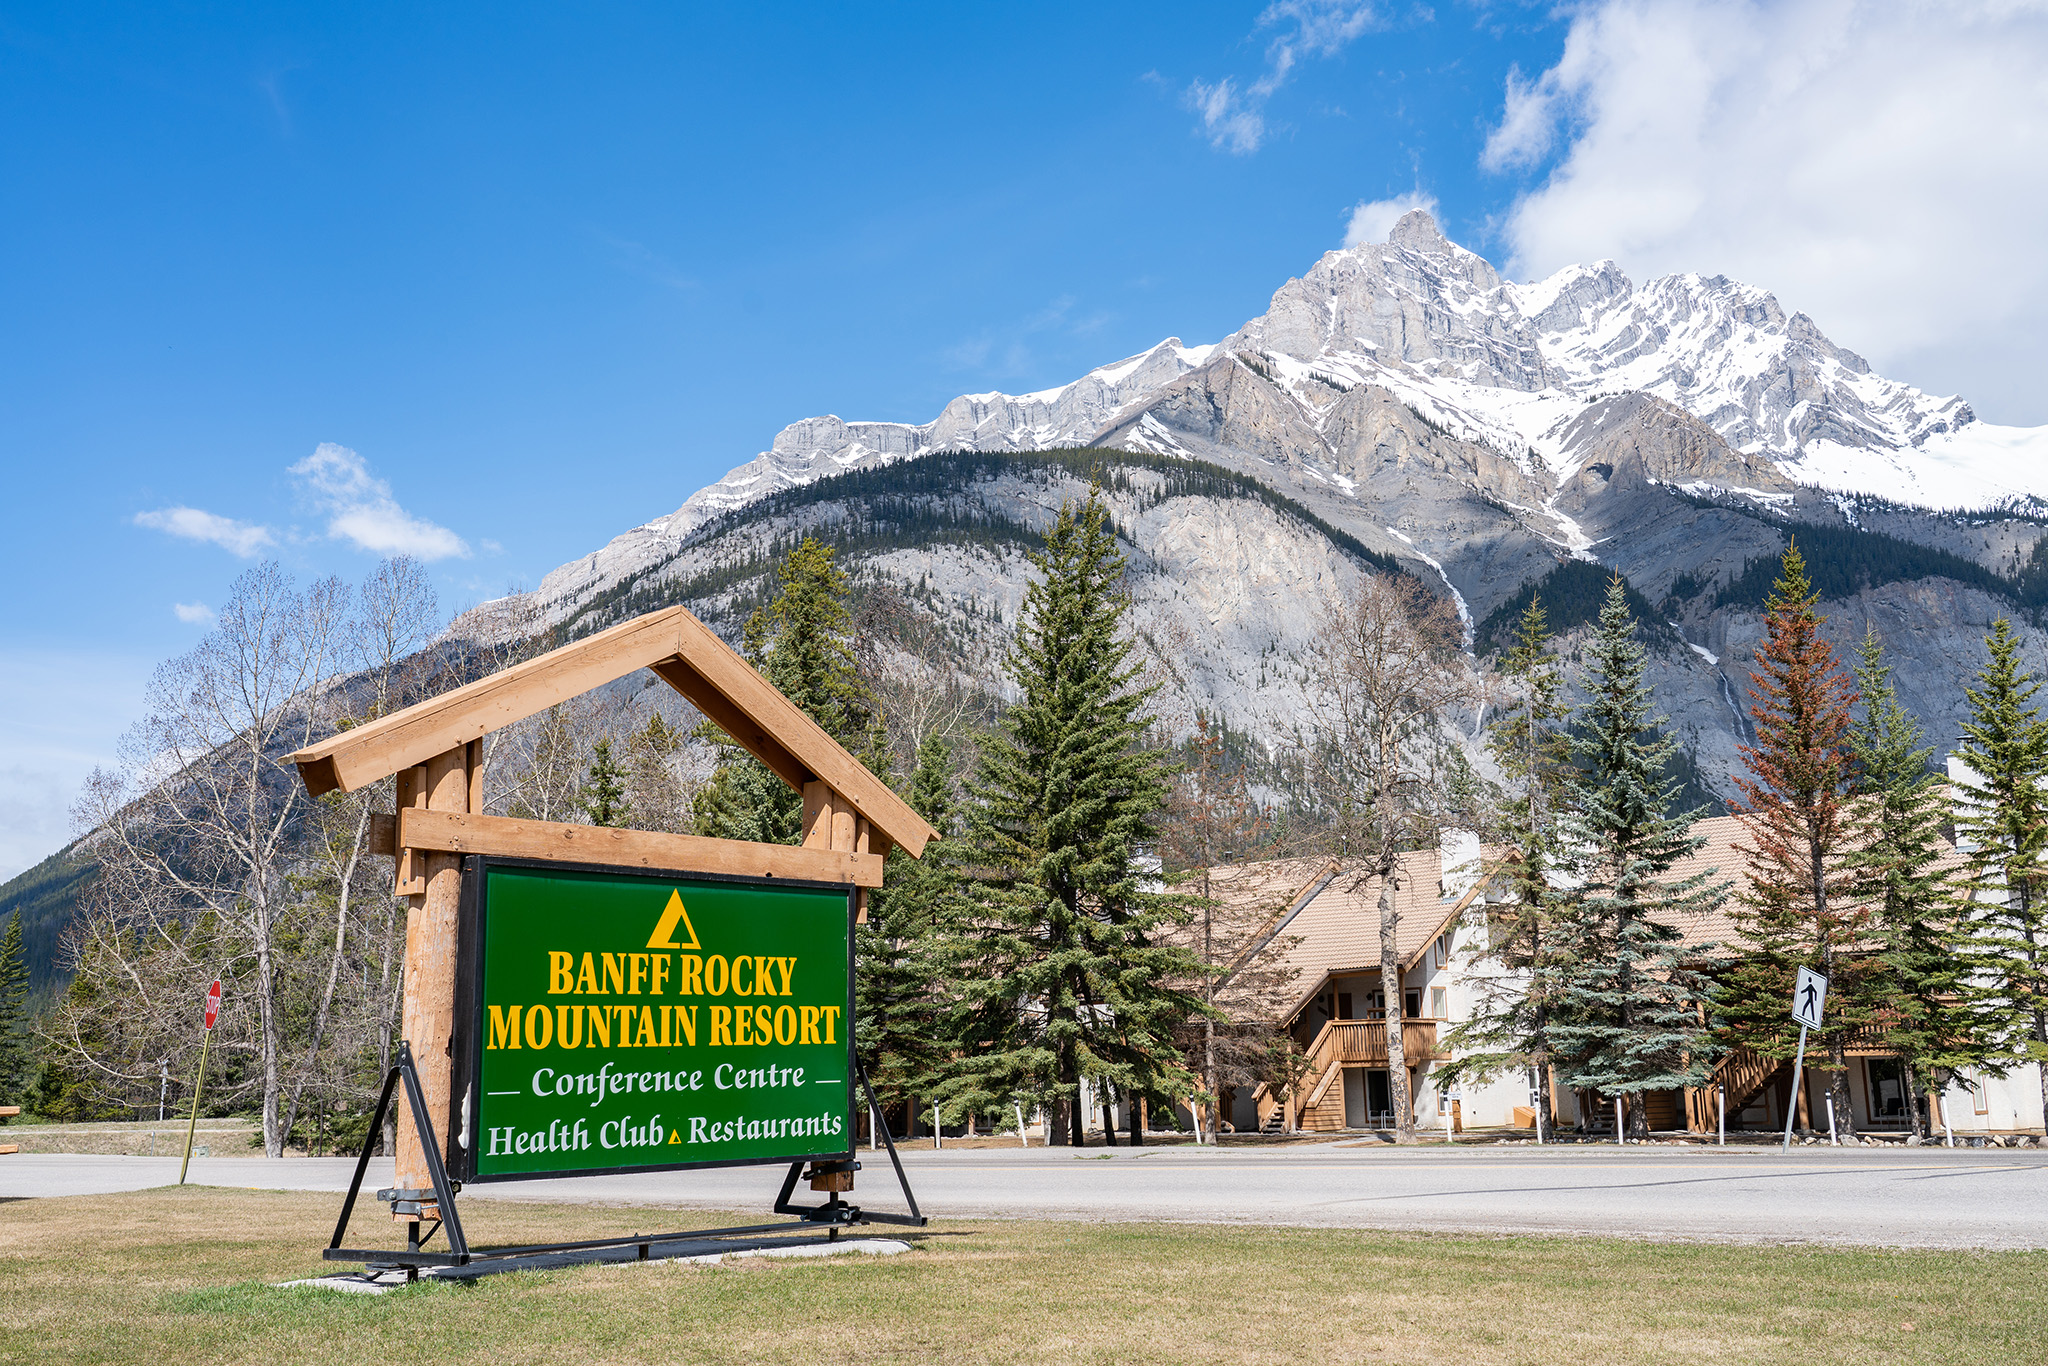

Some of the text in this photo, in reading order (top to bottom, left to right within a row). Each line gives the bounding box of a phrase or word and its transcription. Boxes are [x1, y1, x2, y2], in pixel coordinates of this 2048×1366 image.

[547, 951, 797, 996] BANFF ROCKY
[206, 995, 220, 1014] STOP
[486, 1005, 840, 1050] MOUNTAIN RESORT
[531, 1062, 805, 1107] Conference Centre
[486, 1111, 842, 1156] Health Club Restaurants
